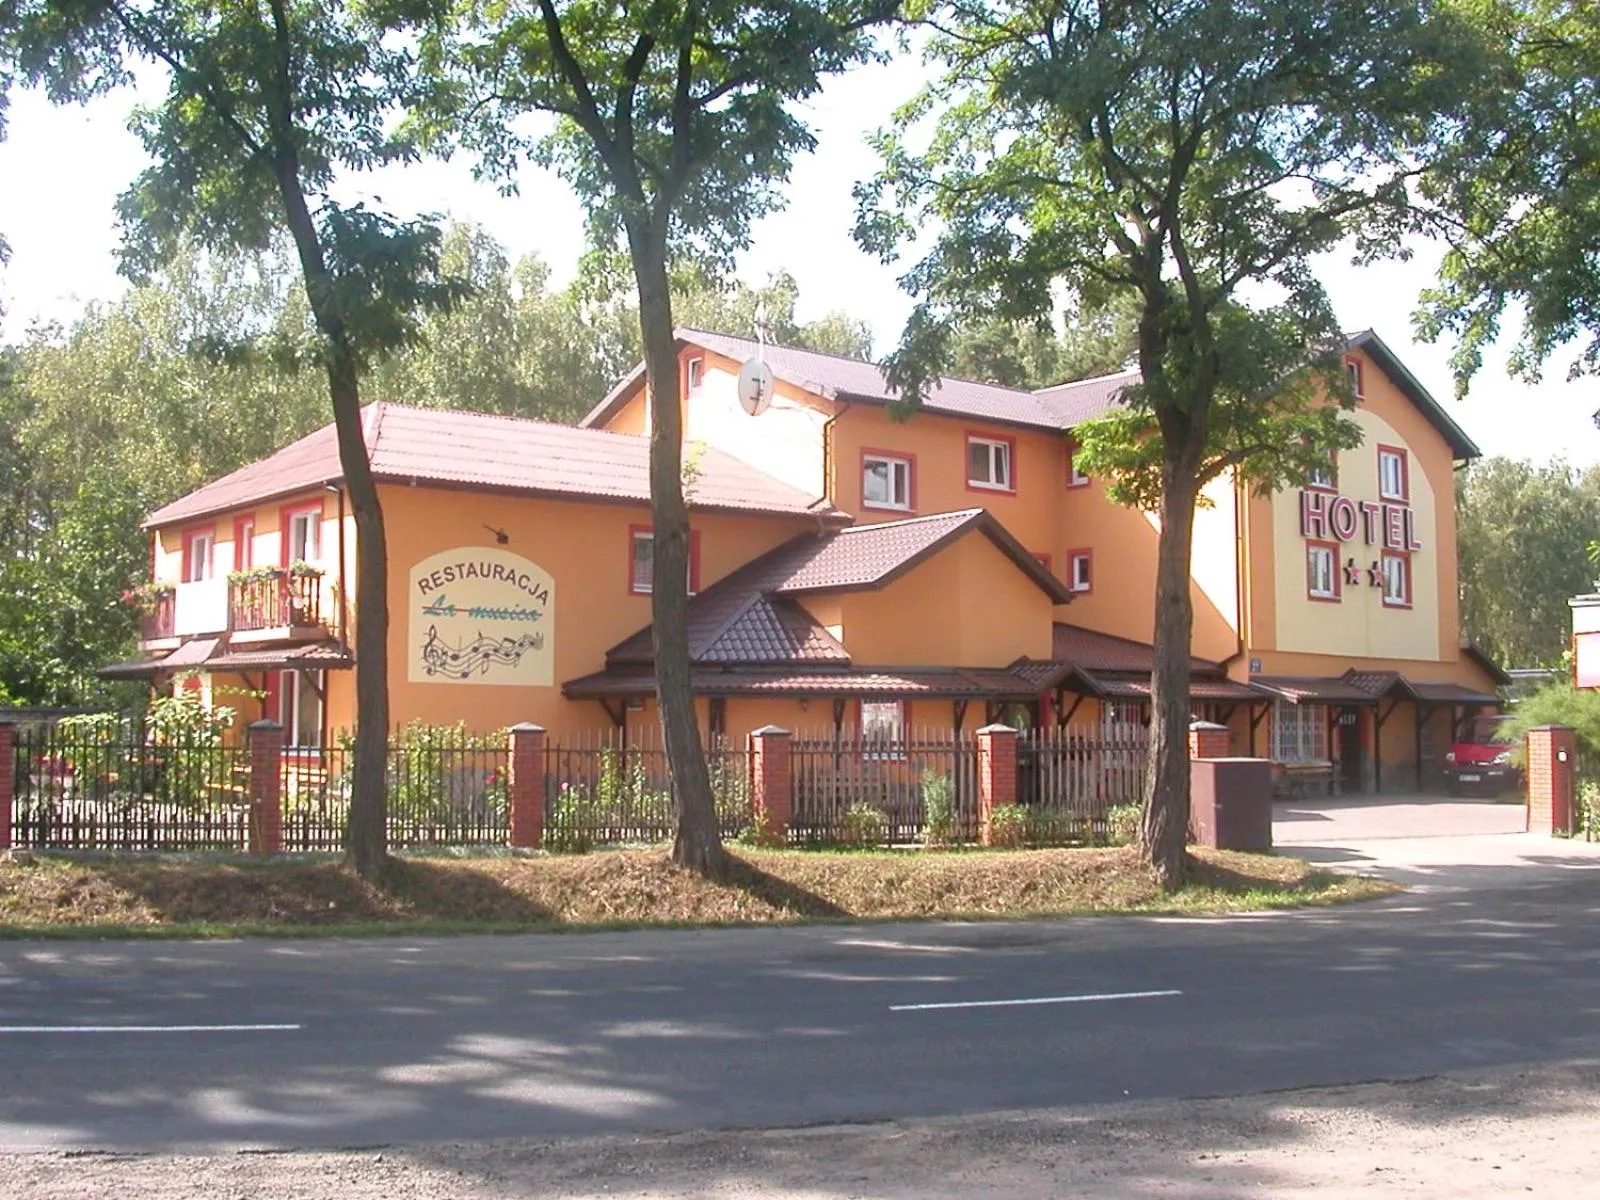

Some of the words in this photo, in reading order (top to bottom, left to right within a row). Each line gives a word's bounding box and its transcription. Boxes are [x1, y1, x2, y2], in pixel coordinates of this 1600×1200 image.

[1299, 491, 1421, 552] HOTEL
[418, 562, 549, 606] RESTAURACJA
[422, 594, 456, 617] La
